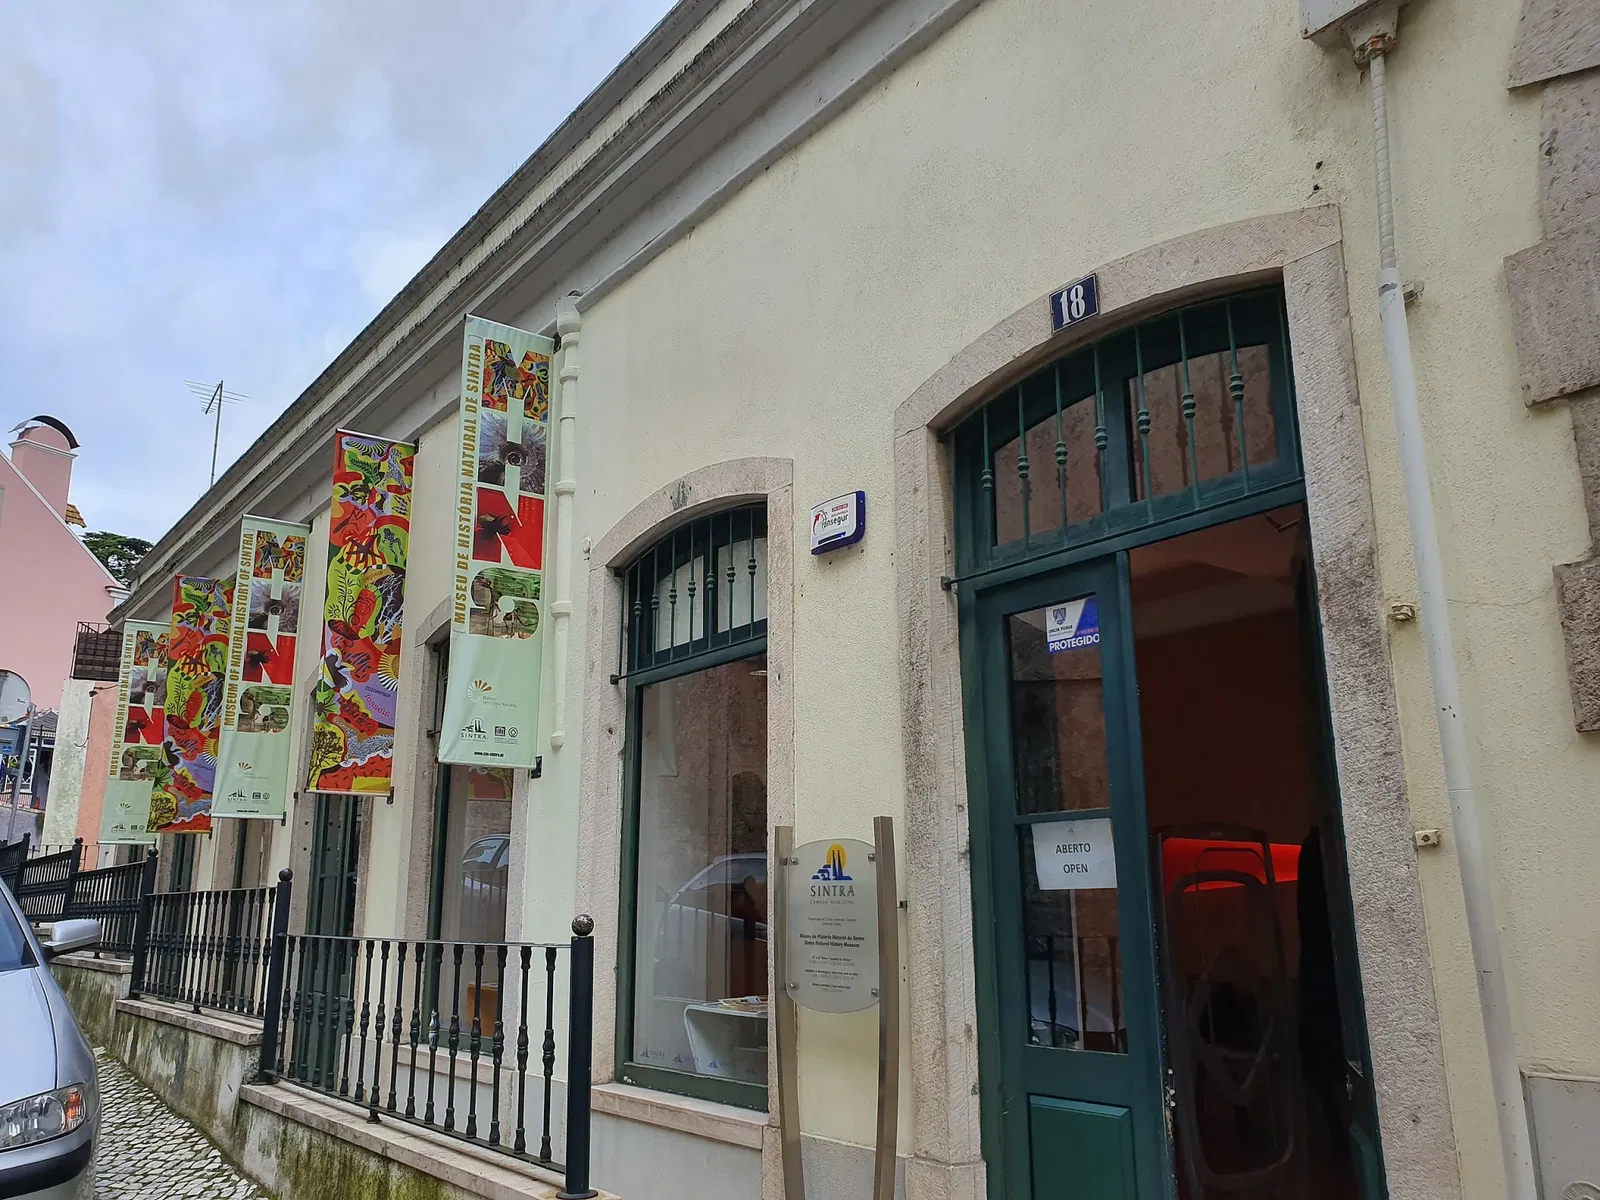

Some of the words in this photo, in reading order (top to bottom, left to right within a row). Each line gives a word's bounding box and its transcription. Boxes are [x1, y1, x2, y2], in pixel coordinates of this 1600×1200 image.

[1060, 285, 1085, 325] 18
[467, 344, 481, 393] SINTRA
[465, 396, 478, 414] DE
[461, 419, 477, 478] NATURAL
[457, 482, 473, 549] HISTÓRIA
[241, 533, 254, 567] SINTRA
[456, 552, 469, 571] DE
[239, 568, 250, 581] OF
[235, 582, 249, 623] HISTORY
[454, 574, 468, 624] MUSEU
[125, 633, 134, 659] SINTRA
[231, 625, 245, 667] NATURAL
[1049, 633, 1100, 652] PROTEGIDO
[123, 660, 131, 669] DE
[229, 668, 240, 680] OF
[119, 669, 130, 701] NATURAL
[365, 685, 391, 698] minerais
[224, 683, 239, 726] MUSEUM
[114, 703, 126, 739] HISTÓRIA
[113, 740, 121, 748] DE
[109, 751, 120, 776] MUSEU
[1055, 843, 1091, 854] ABERTO
[1063, 863, 1089, 873] OPEN
[810, 885, 855, 897] SINTRA
